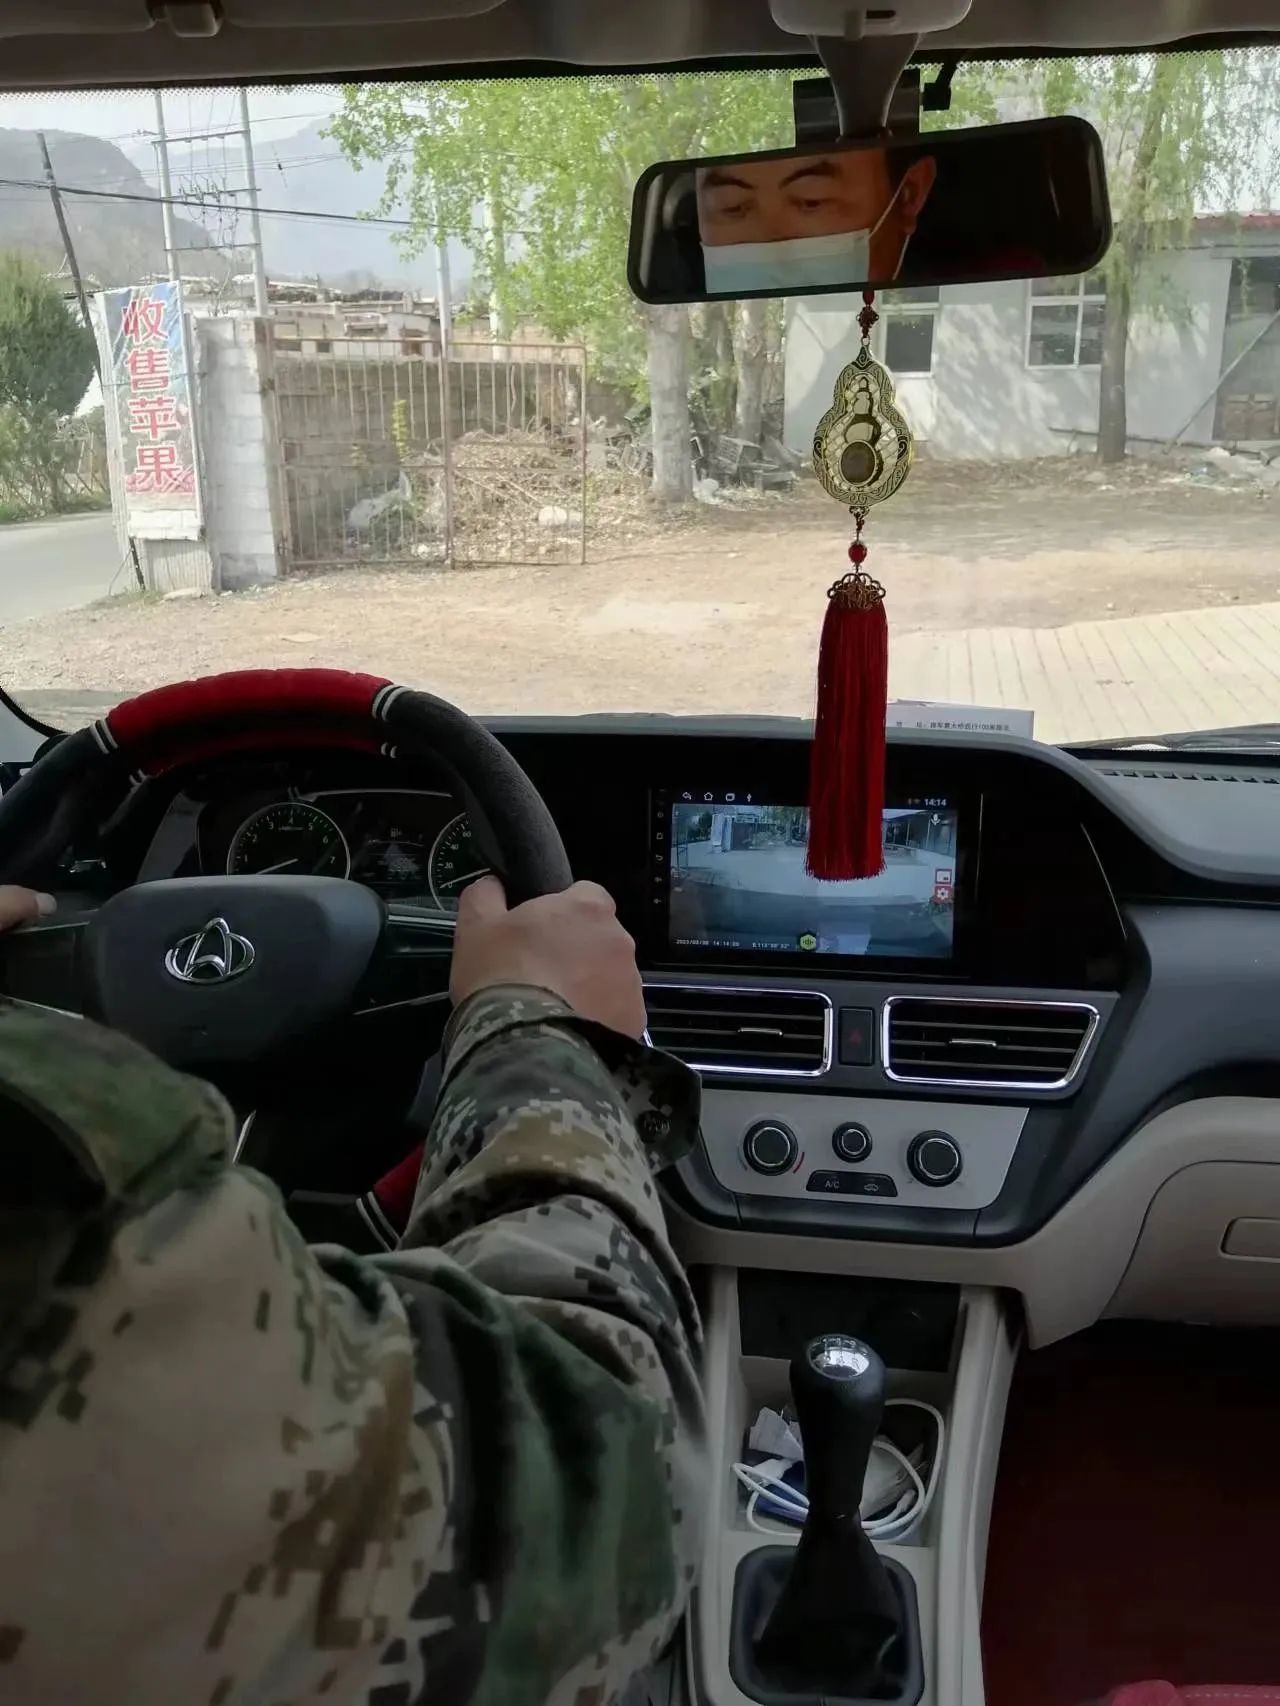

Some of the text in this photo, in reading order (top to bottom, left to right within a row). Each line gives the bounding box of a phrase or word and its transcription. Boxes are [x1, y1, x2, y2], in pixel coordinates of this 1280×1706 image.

[121, 296, 183, 486] 收售苹果
[924, 798, 947, 807] 14:14
[825, 1180, 841, 1189] A/C
